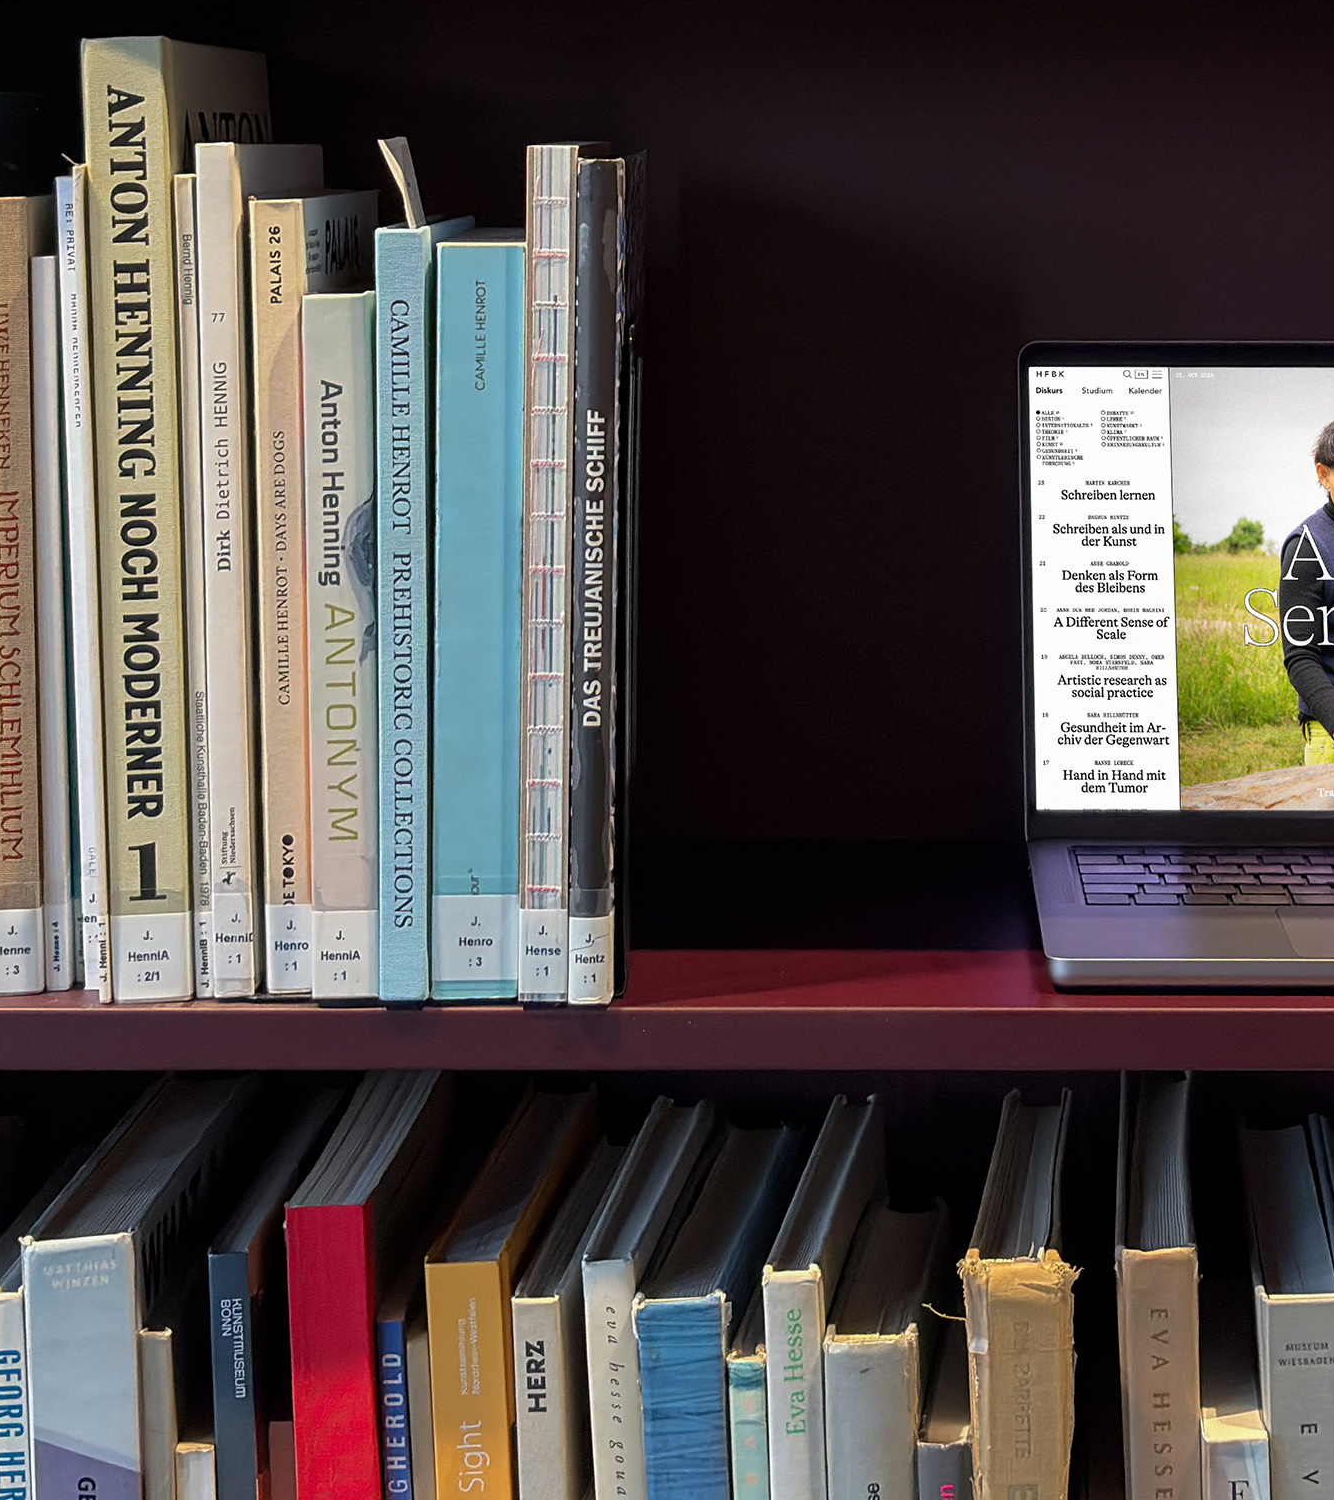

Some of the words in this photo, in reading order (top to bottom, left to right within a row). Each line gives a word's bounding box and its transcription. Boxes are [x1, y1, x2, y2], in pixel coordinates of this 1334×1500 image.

[107, 86, 150, 247] ANTON
[270, 226, 281, 245] 26
[270, 251, 283, 304] PALAIS
[113, 259, 157, 479] HENNING
[390, 300, 410, 416] CAMILLE
[320, 380, 344, 464] Anton
[587, 409, 605, 494] SCHIFF
[392, 425, 412, 534] HENROT
[1061, 490, 1117, 500] Schreiben
[1120, 490, 1155, 500] lernen
[119, 492, 159, 602] NOCH
[319, 471, 345, 586] Henning
[1282, 524, 1334, 580] A
[583, 498, 605, 673] TREUJANISCHE
[393, 551, 412, 731] PREHISTORIC
[1058, 675, 1101, 685] Artistic
[1104, 675, 1152, 685] research
[1155, 677, 1167, 685] as
[123, 612, 165, 820] MODERNER
[325, 602, 358, 843] ANTONYM
[583, 680, 601, 728] DAS
[1072, 688, 1104, 698] social
[1107, 688, 1153, 700] practice
[0, 645, 25, 861] SCHLEMIHLIUM
[129, 843, 166, 902] 1
[394, 738, 414, 929] COLLECTIONS
[220, 1300, 232, 1337] BONN
[231, 1298, 247, 1398] KUNSTMUSEUM
[785, 1308, 802, 1384] Hesse
[527, 1340, 547, 1413] HERZ
[784, 1390, 806, 1435] Eva
[458, 1420, 489, 1492] Sight
